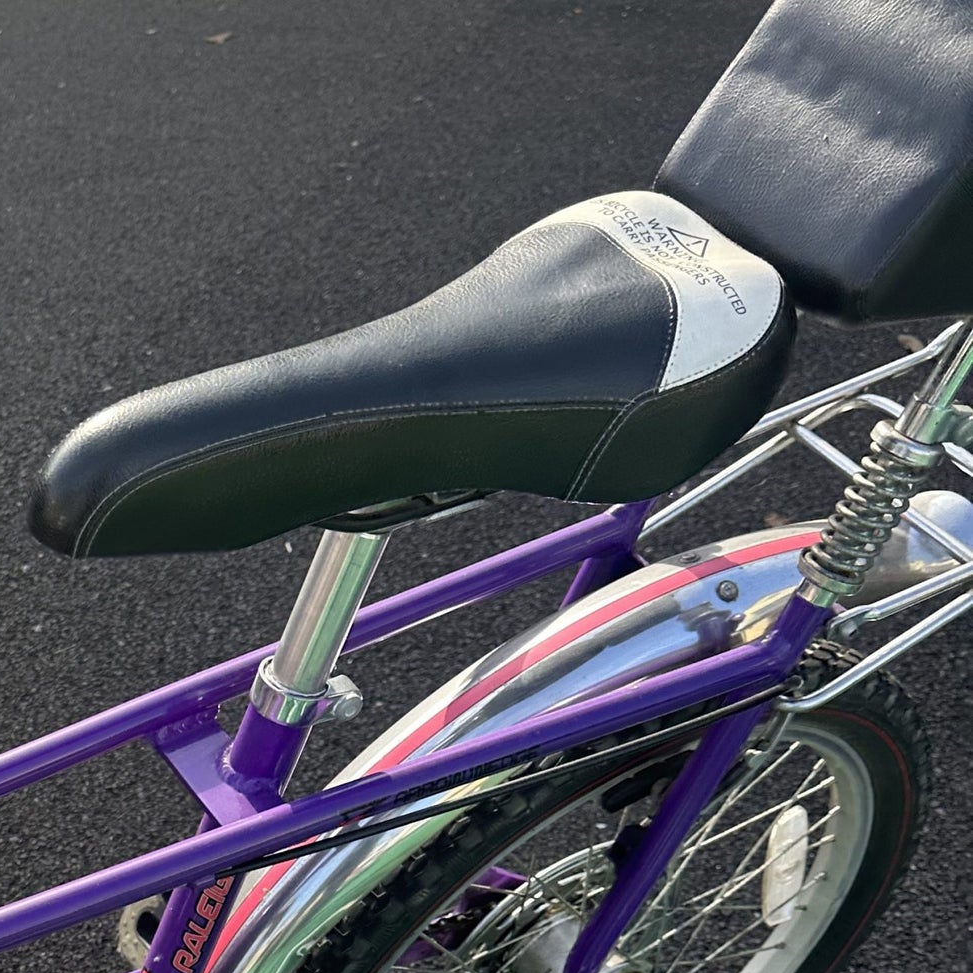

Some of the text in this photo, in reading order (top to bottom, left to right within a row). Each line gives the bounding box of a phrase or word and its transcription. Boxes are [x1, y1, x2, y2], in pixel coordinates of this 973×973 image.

[597, 207, 615, 216] TO
[612, 215, 645, 245] CARRY
[604, 200, 645, 229] BICYCLE
[639, 229, 655, 244] IS
[651, 245, 677, 260] NOT
